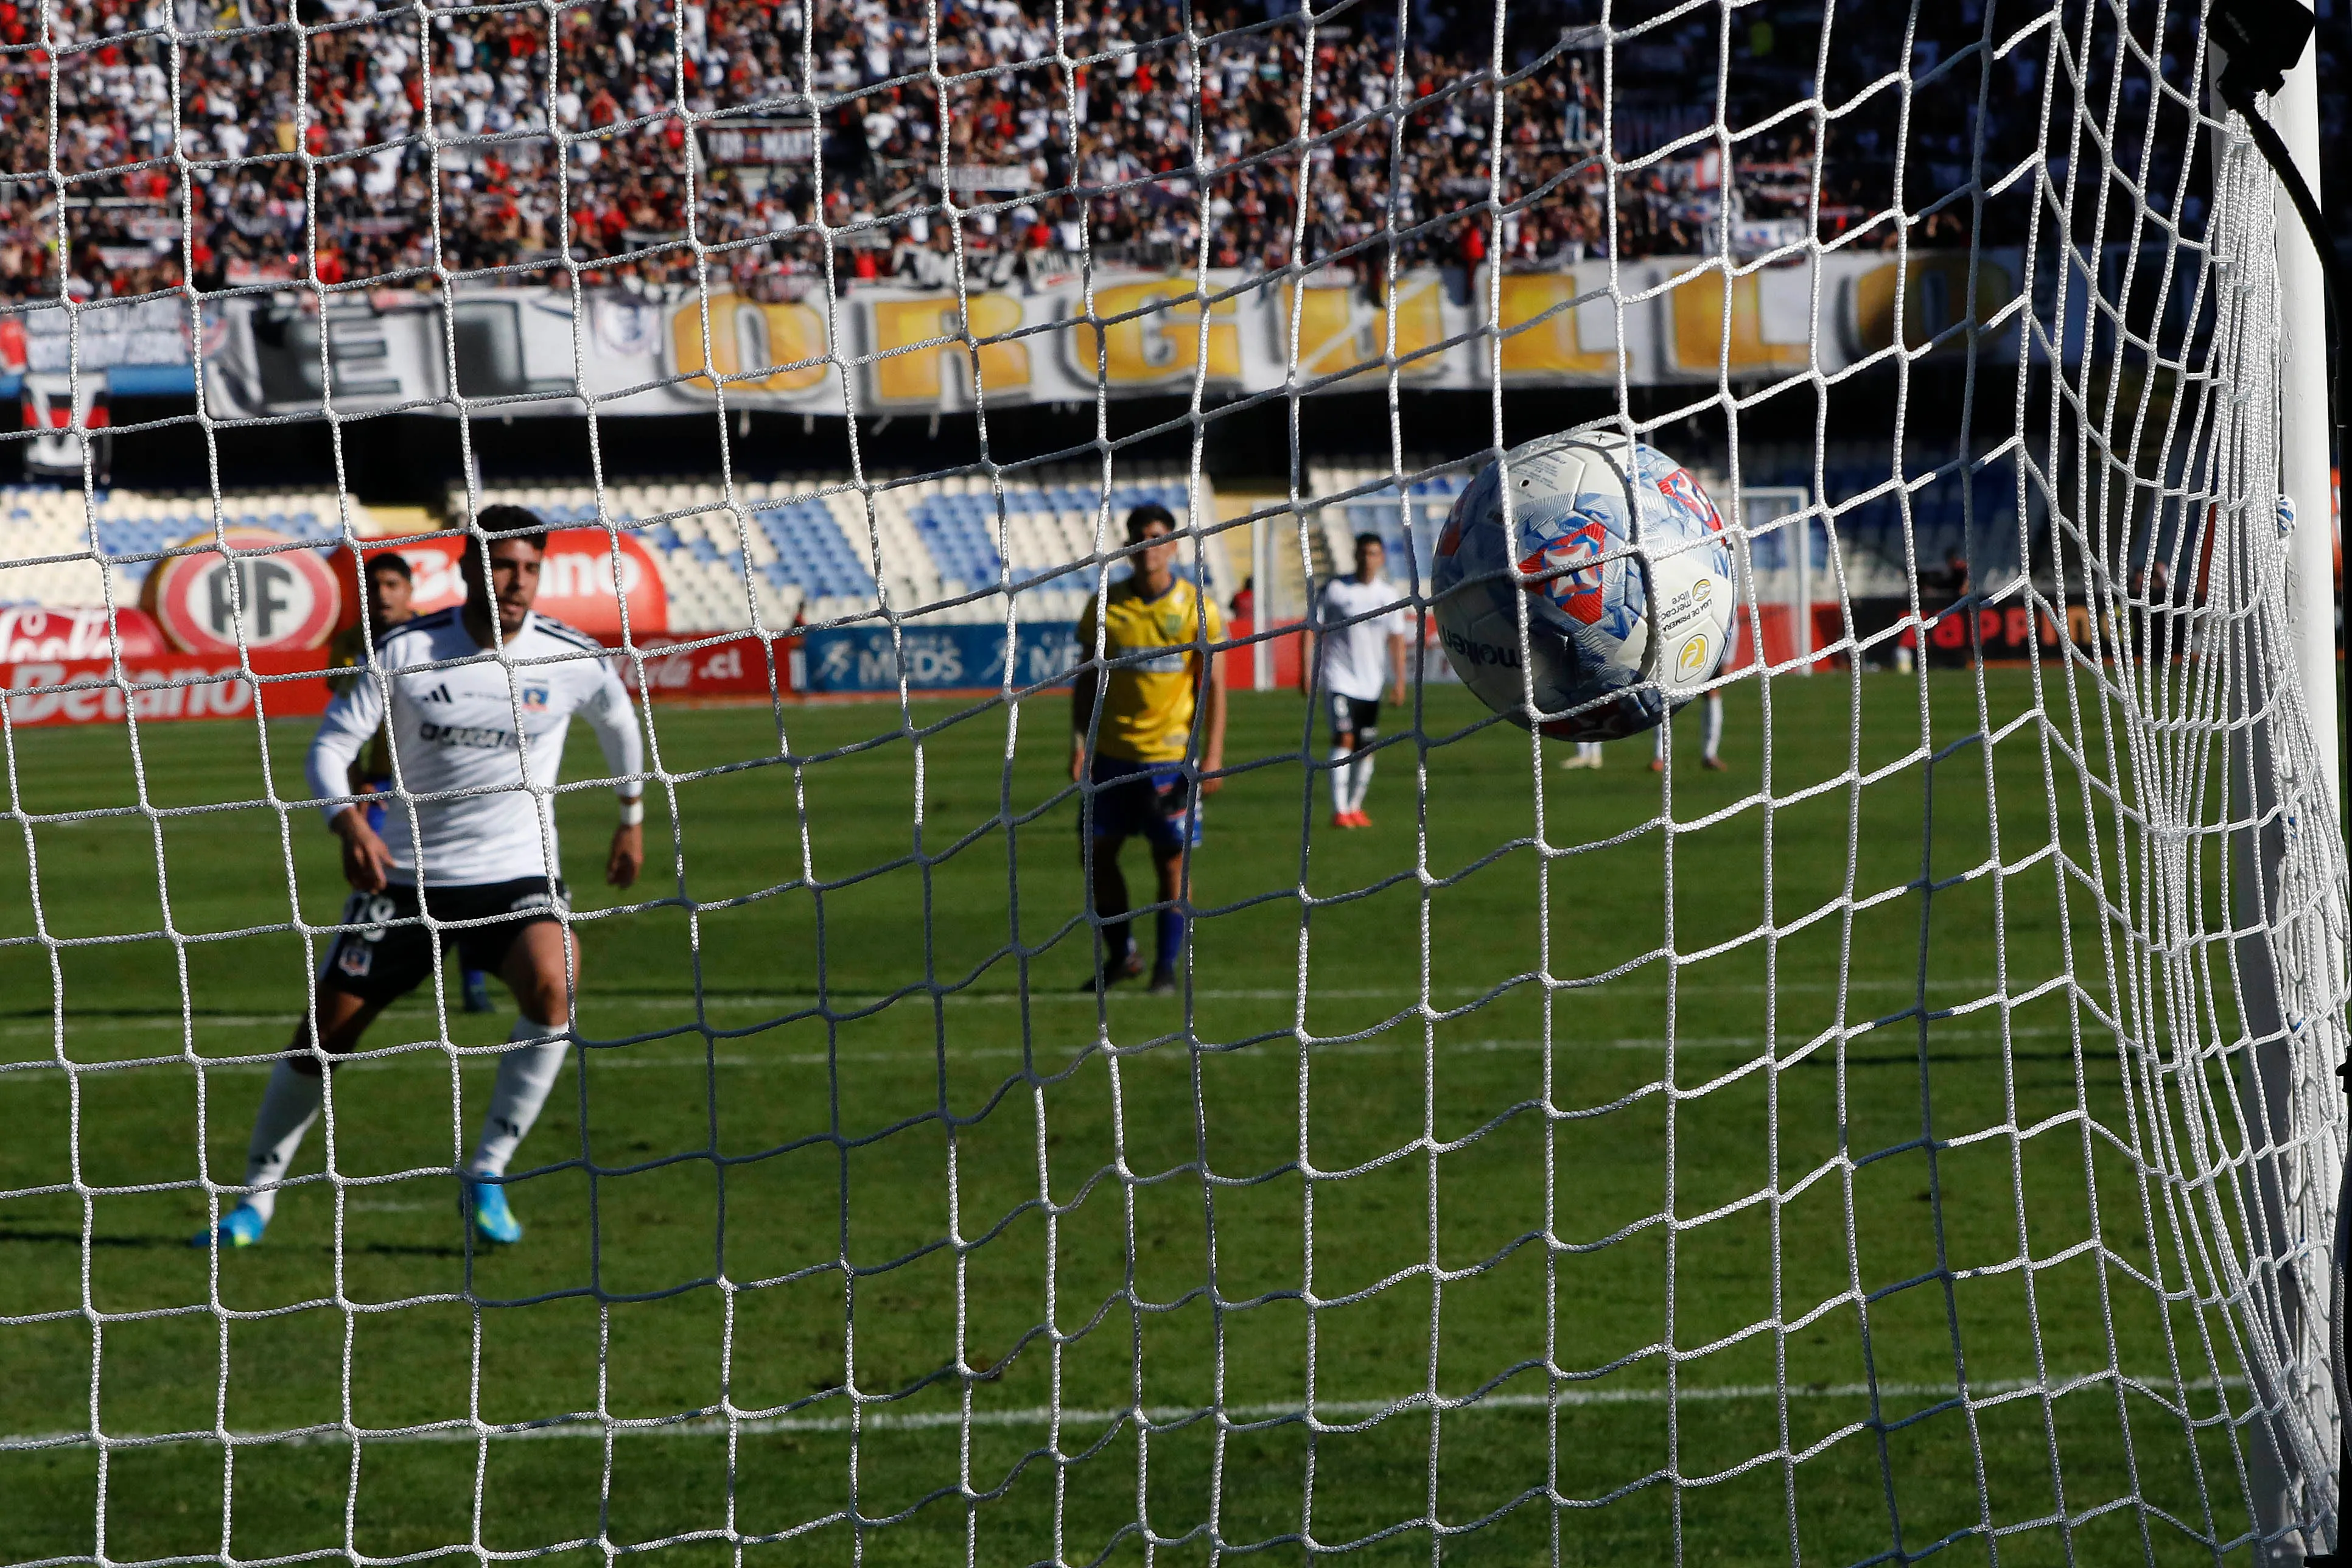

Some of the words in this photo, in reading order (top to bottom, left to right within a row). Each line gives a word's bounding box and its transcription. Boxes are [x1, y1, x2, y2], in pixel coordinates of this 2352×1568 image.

[1671, 590, 1690, 604] libre
[1699, 598, 1712, 612] LIGA
[1690, 607, 1701, 618] DE
[1662, 613, 1692, 632] PRIMERA
[858, 648, 964, 681] MEDS
[10, 663, 253, 723] Betano
